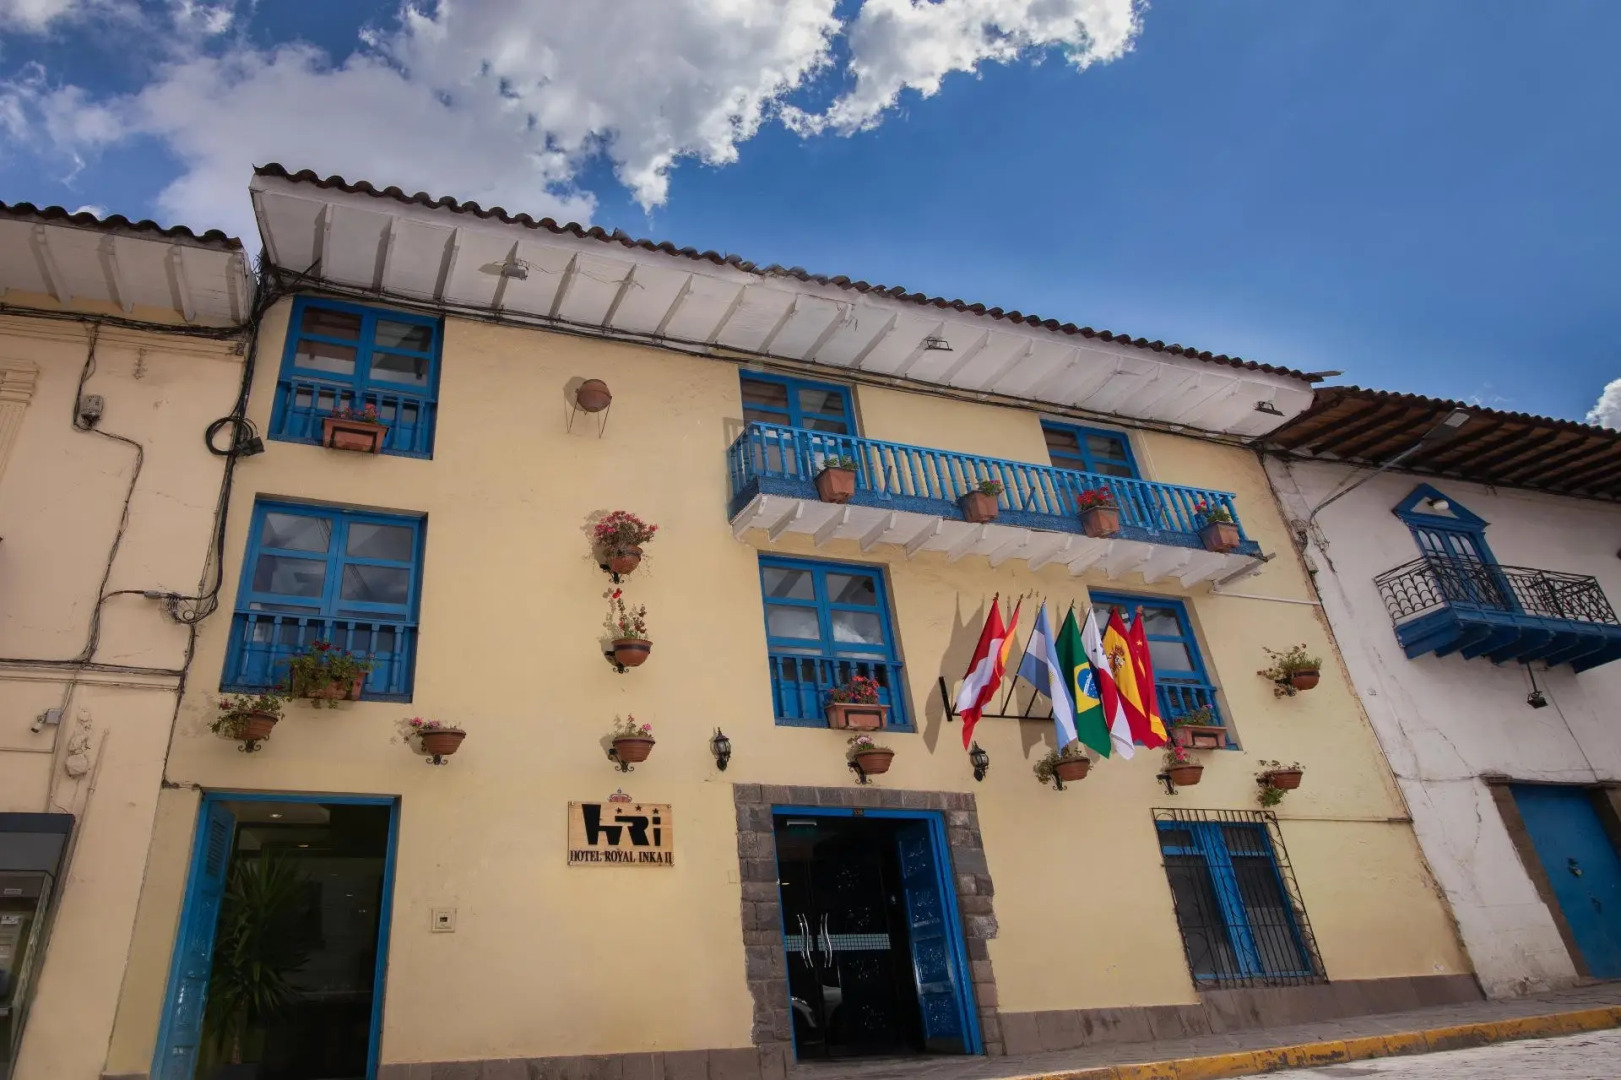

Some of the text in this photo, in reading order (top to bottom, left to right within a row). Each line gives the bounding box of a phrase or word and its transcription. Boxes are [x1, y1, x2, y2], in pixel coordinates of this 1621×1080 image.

[570, 850, 602, 862] HOTEL
[605, 850, 636, 863] ROYAL
[639, 851, 663, 863] INKA
